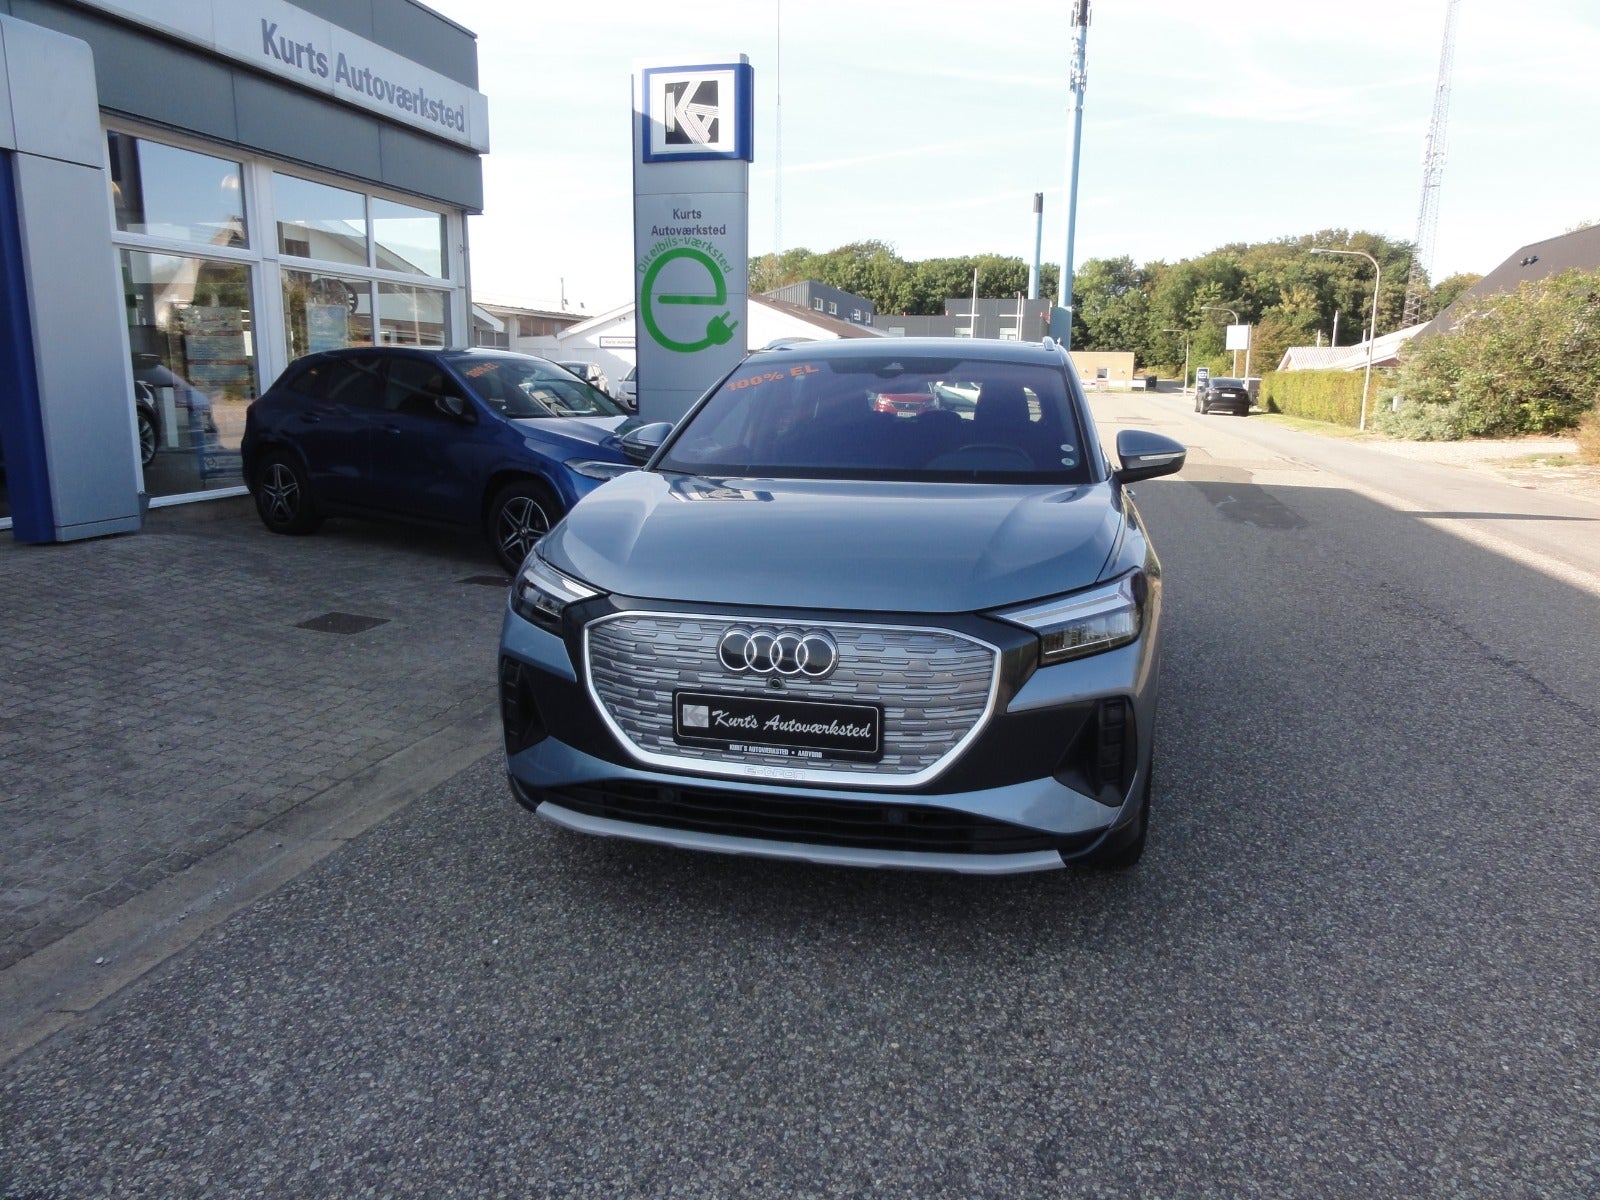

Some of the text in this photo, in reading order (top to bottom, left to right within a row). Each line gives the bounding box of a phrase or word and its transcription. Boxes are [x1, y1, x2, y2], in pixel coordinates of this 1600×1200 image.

[261, 18, 465, 132] Kurts Autoværksted
[672, 208, 702, 220] Kurts
[651, 224, 727, 237] Autoværksted
[727, 364, 820, 391] 100% EL
[712, 709, 872, 739] Kurt's Autoværksted
[744, 765, 806, 780] e-tron
